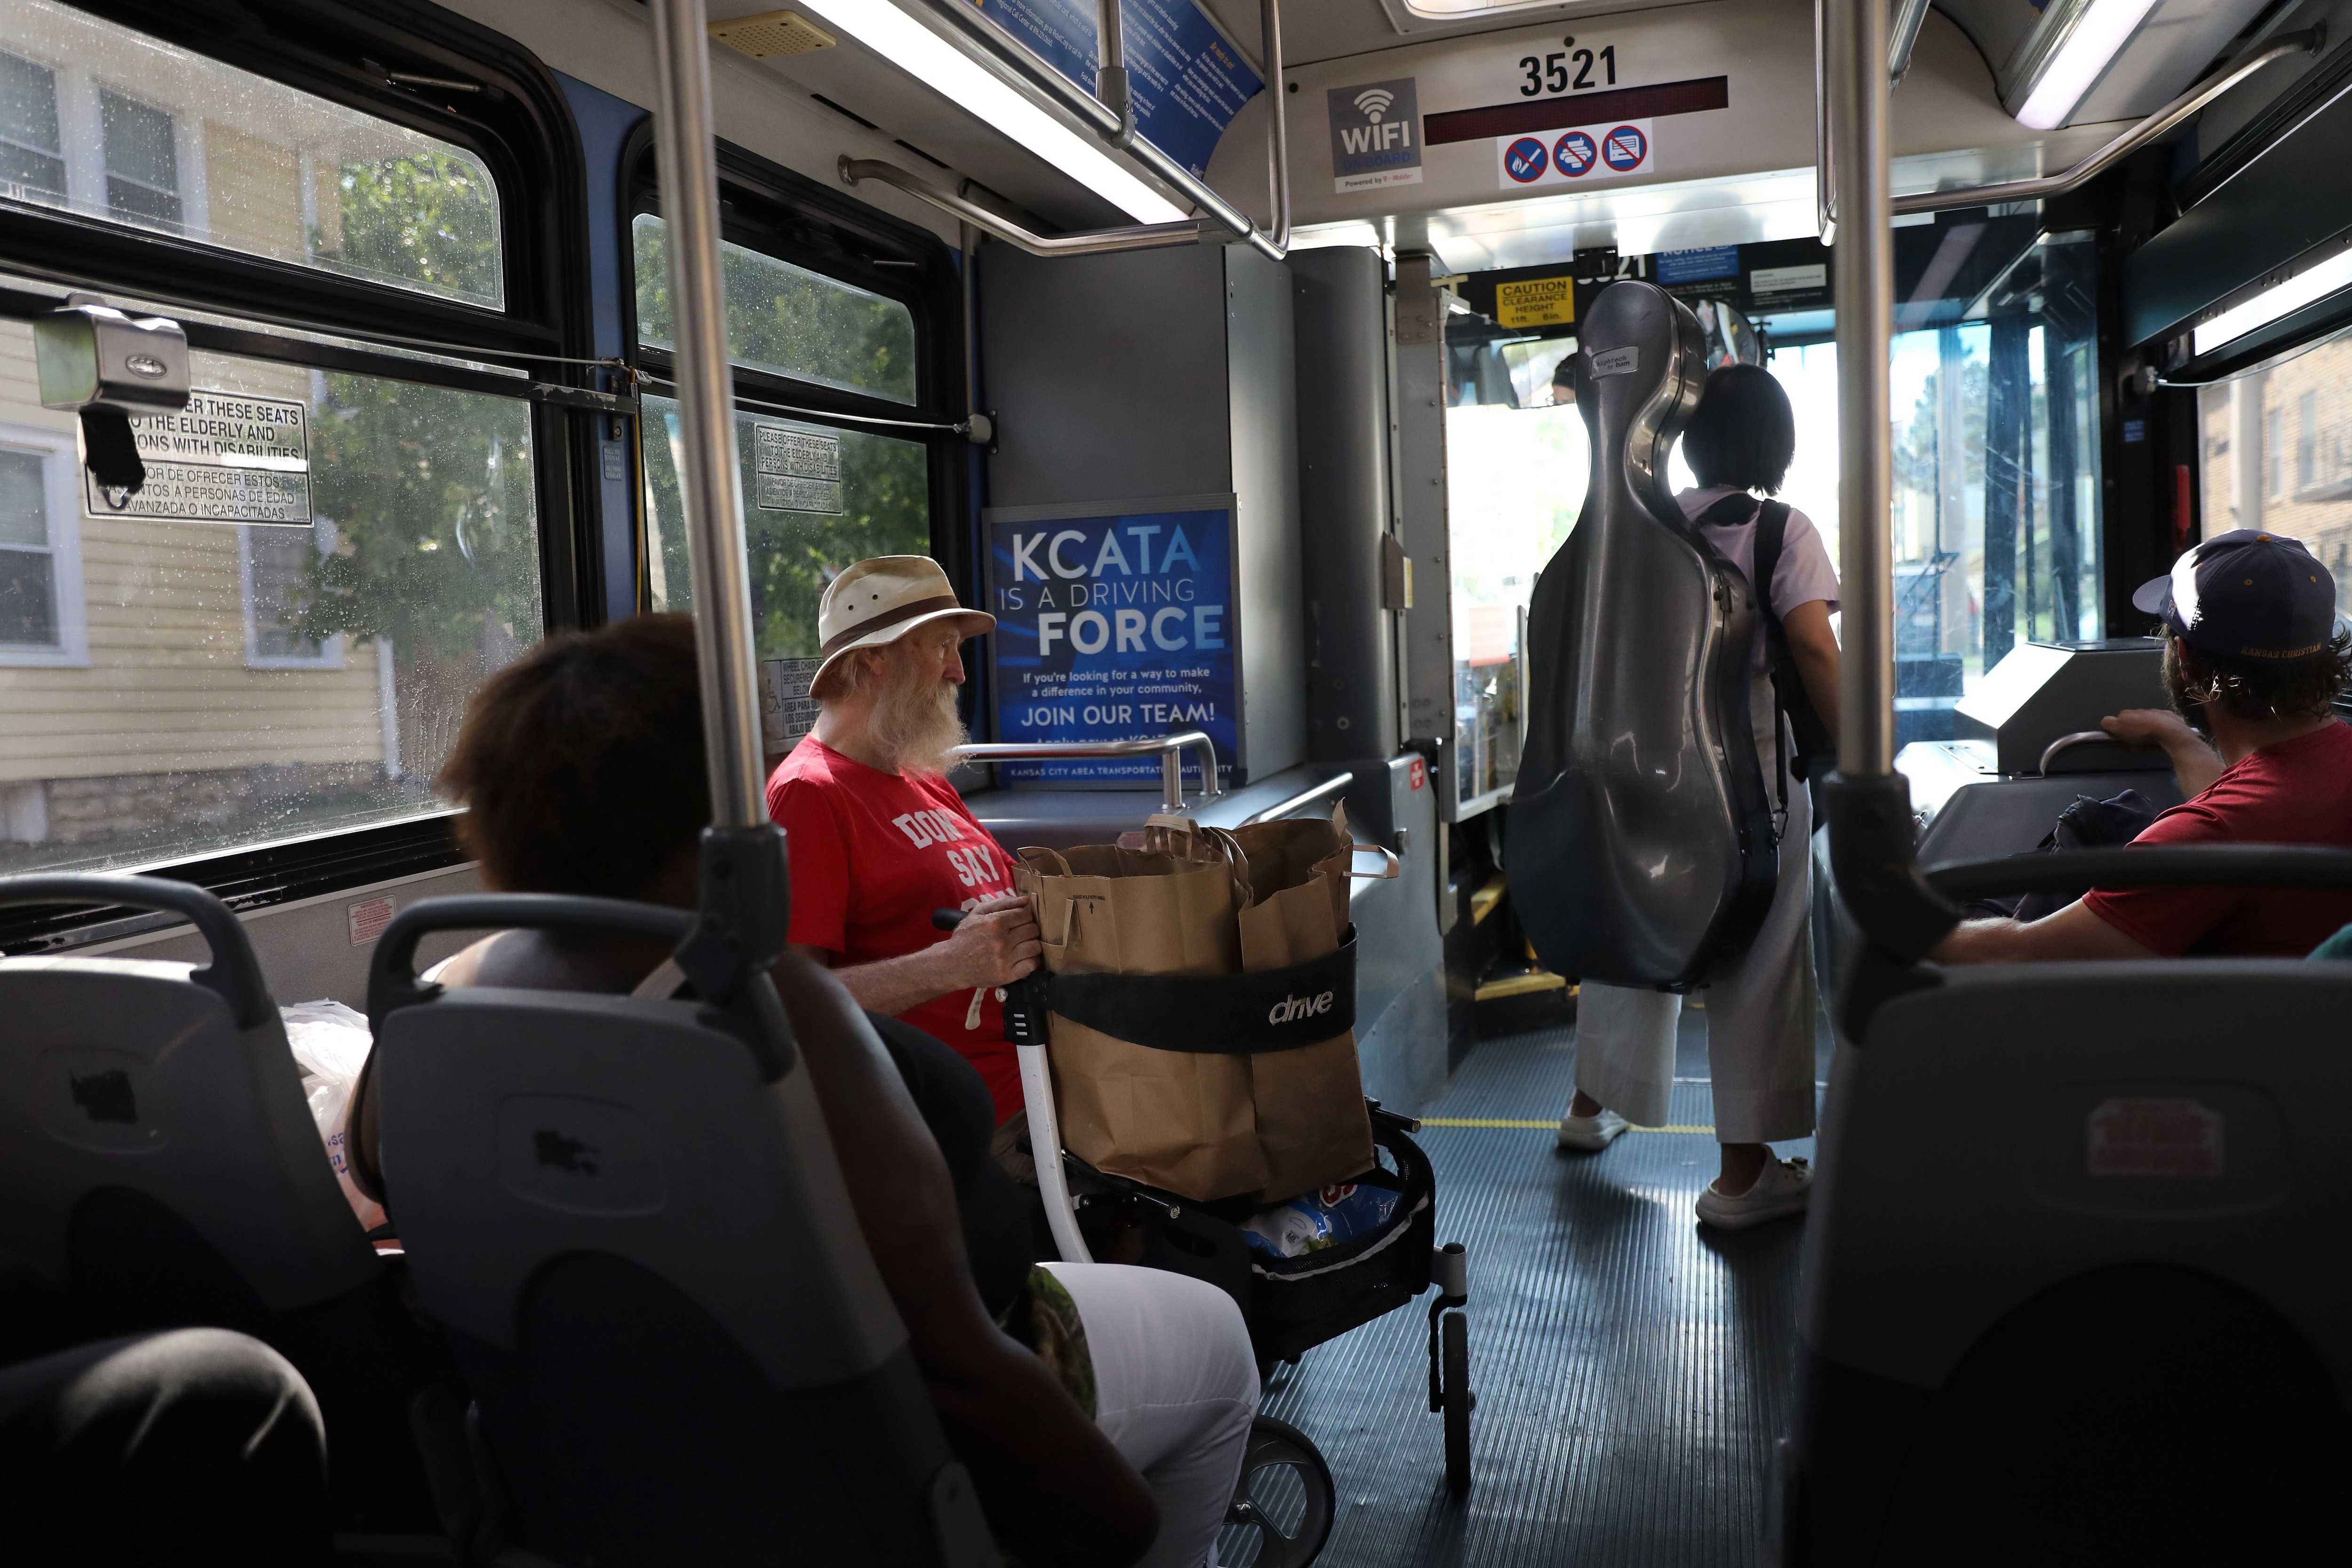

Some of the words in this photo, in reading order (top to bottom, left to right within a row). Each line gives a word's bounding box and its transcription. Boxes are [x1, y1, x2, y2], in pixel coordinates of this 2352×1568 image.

[1519, 46, 1615, 96] 3521
[1343, 158, 1362, 170] ON
[1365, 152, 1411, 167] BOARD
[1345, 177, 1373, 187] Powered
[1503, 281, 1566, 296] CAUTION
[1503, 294, 1566, 306] CLEARANCE
[1516, 303, 1554, 314] HEIGHT
[207, 399, 253, 420] THESE
[257, 406, 299, 425] SEATS
[149, 416, 176, 432] THE
[180, 417, 243, 439] ELDERLY
[247, 425, 274, 441] AND
[174, 437, 210, 456] WITH
[759, 431, 782, 444] PLEASE
[783, 435, 801, 446] OFFER
[802, 438, 819, 450] THESE
[820, 440, 836, 452] SEATS
[771, 446, 778, 456] TO
[780, 447, 791, 458] THE
[793, 449, 815, 462] ELDERLY
[817, 452, 827, 462] AND
[762, 457, 788, 470] PERSONS
[790, 462, 803, 472] WITH
[804, 463, 837, 476] DISABILITIES
[168, 469, 184, 481] DE
[187, 470, 241, 485] OFRECER
[245, 474, 279, 488] ESTOS
[175, 486, 183, 498] A
[185, 486, 246, 501] PERSONAS
[249, 490, 264, 502] DE
[267, 492, 294, 504] EDAD
[124, 500, 187, 514] AVANZADA
[189, 503, 198, 515] O
[201, 504, 285, 519] INCAPACITADAS
[1013, 524, 1201, 581] KCATA
[1001, 587, 1024, 611] IS
[1038, 587, 1056, 609] A
[1071, 579, 1195, 608] DRIVING
[1039, 605, 1224, 656] FORCE
[2244, 647, 2280, 658] KANSAS
[2282, 642, 2322, 658] CHRISTIAN
[783, 661, 800, 672] WHEEL
[801, 661, 815, 671] CHAIR
[1023, 673, 1031, 684] If
[1034, 672, 1066, 685] you're
[1069, 670, 1109, 684] looking
[1112, 669, 1128, 681] for
[1130, 671, 1137, 680] a
[1140, 671, 1162, 682] way
[1165, 669, 1177, 679] to
[1180, 667, 1210, 678] make
[1041, 685, 1093, 698] difference
[1097, 685, 1107, 695] in
[1110, 685, 1134, 697] your
[1137, 682, 1201, 695] community,
[798, 700, 810, 712] PARA
[1021, 707, 1075, 727] JOIN
[1083, 705, 1132, 724] OUR
[1140, 703, 1215, 724] TEAM!
[785, 713, 795, 724] LOS
[789, 724, 804, 734] ABAJO
[1071, 767, 1095, 775] AREA
[1097, 765, 1164, 775] TRANSPORTATI
[946, 844, 1000, 887] SAY
[1269, 991, 1333, 1026] drive
